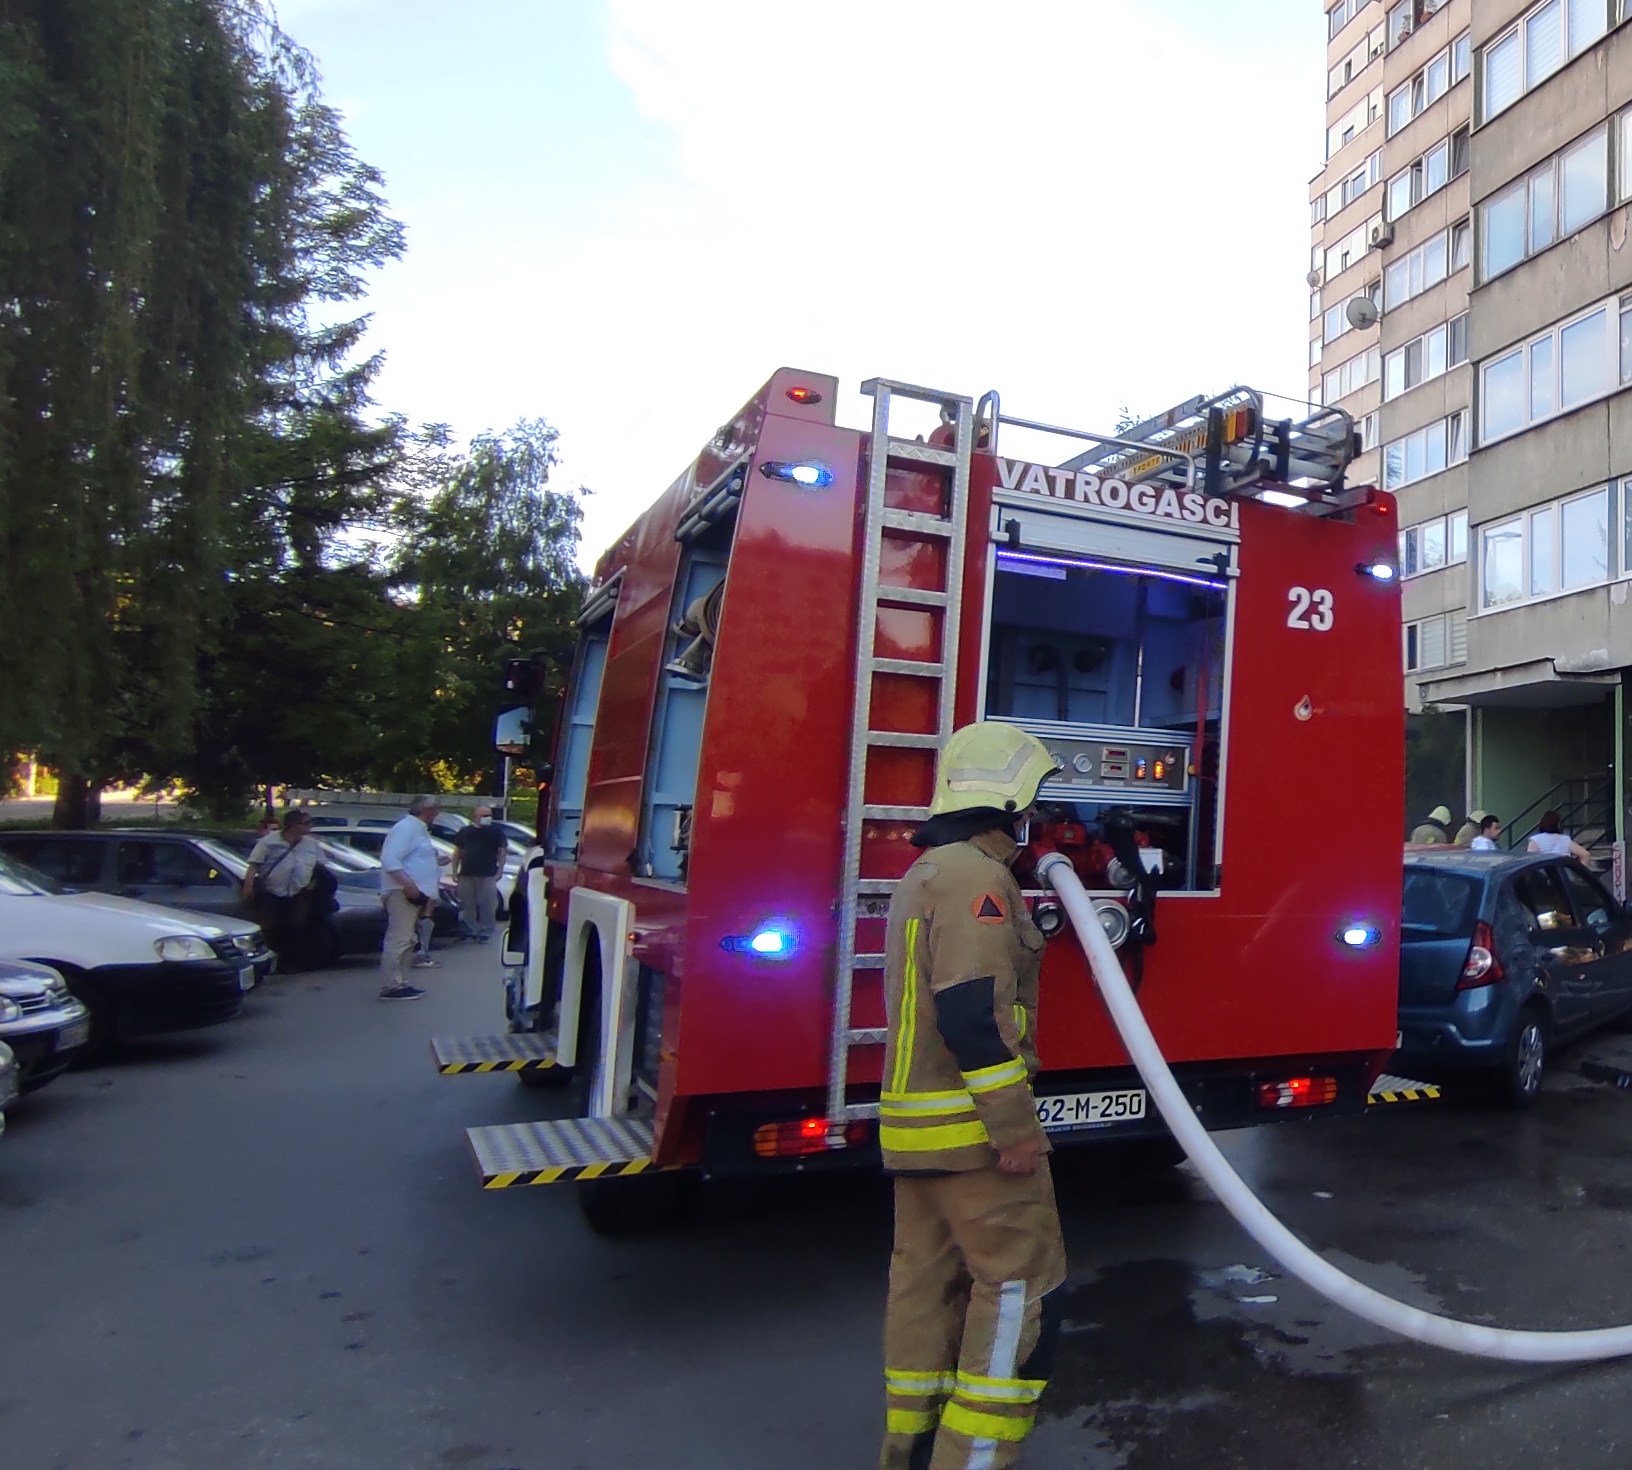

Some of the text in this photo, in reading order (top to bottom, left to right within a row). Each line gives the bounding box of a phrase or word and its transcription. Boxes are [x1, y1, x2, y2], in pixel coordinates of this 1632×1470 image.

[995, 456, 1241, 530] VATROGASCI
[1286, 586, 1334, 632] 23
[1038, 1093, 1142, 1123] 62-M-250
